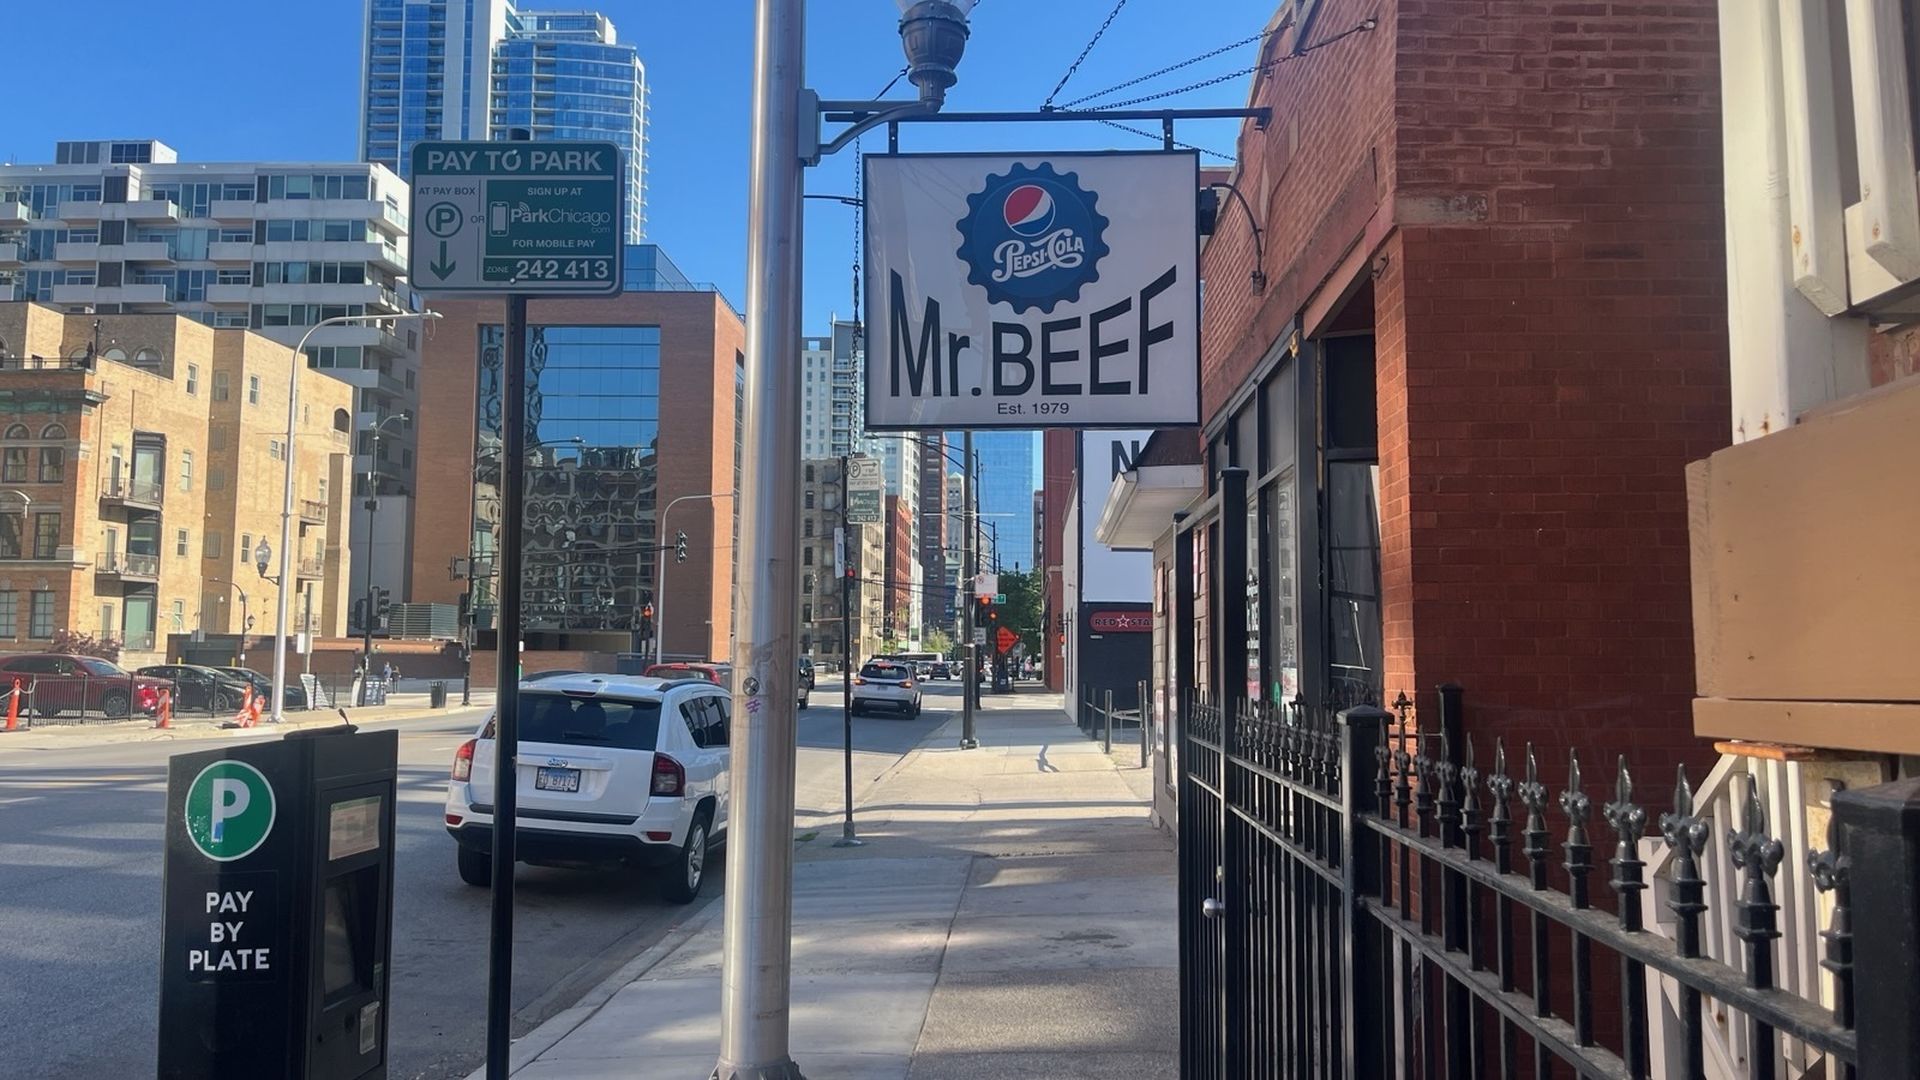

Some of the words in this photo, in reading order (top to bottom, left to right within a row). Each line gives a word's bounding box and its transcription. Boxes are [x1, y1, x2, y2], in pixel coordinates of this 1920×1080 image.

[427, 150, 478, 171] PAY
[484, 149, 522, 172] TO
[530, 150, 603, 171] PARK
[418, 186, 431, 196] AT
[433, 186, 452, 196] PAY
[454, 186, 476, 196] BOX
[527, 187, 552, 196] SIGN
[554, 187, 568, 196] UP
[570, 187, 583, 196] AT
[435, 208, 456, 232] P
[470, 215, 486, 225] OR
[510, 207, 611, 227] ParkChicago
[512, 239, 534, 248] FOR
[535, 239, 575, 248] MOBILE
[576, 239, 597, 248] PAY
[486, 265, 510, 274] ZONE
[515, 260, 559, 279] 242
[564, 260, 609, 279] 413
[890, 268, 982, 397] Mr.
[992, 264, 1177, 397] BEEF
[997, 402, 1026, 415] Est.
[1032, 402, 1070, 415] 1979
[1095, 618, 1116, 626] RED
[210, 777, 251, 843] P
[205, 890, 254, 914] PAY
[210, 921, 244, 943] BY
[189, 948, 270, 971] PLATE
